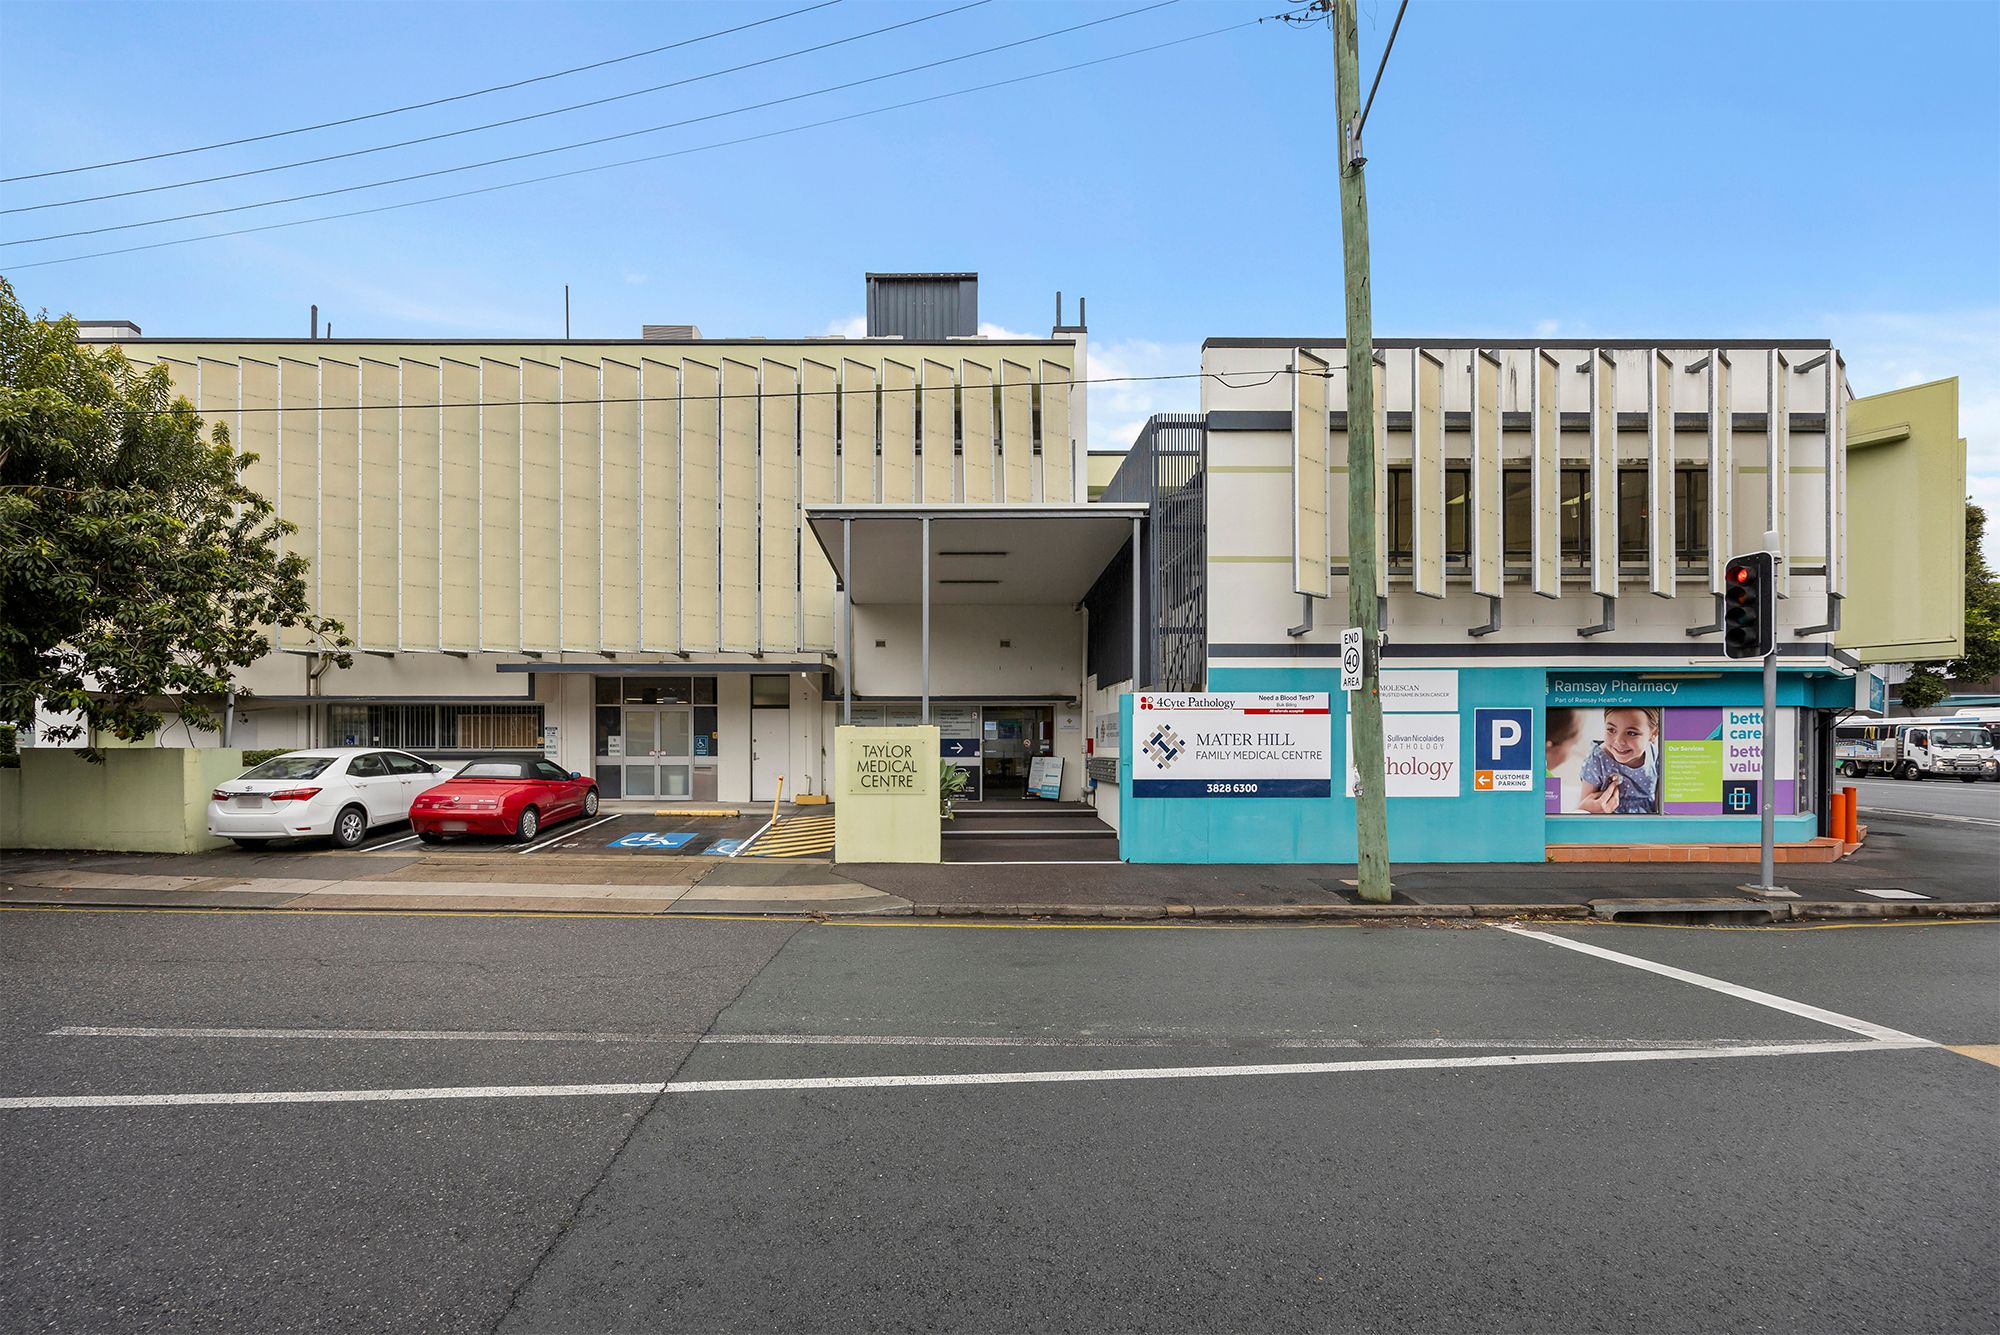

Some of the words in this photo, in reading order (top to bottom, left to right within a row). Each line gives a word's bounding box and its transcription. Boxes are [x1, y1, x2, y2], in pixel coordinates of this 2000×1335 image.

[1344, 632, 1359, 645] END
[1346, 654, 1358, 667] 40
[1343, 677, 1360, 687] AREA
[1554, 680, 1608, 695] Ramsay
[1611, 680, 1679, 695] Pharmacy
[1156, 697, 1186, 709] 4Cyte
[1188, 696, 1236, 710] Pathology
[1730, 712, 1764, 725] bett
[1196, 733, 1253, 746] MATER
[1257, 733, 1296, 746] HILL
[1387, 734, 1412, 742] Sullivan
[1412, 734, 1445, 742] Nicolaides
[1491, 719, 1522, 760] P
[862, 744, 912, 758] TAYLOR
[1195, 750, 1231, 760] FAMILY
[1233, 750, 1280, 760] MEDICAL
[1281, 750, 1323, 760] CENTRE
[1730, 745, 1764, 758] bett
[857, 760, 918, 773] MEDICAL
[1384, 756, 1454, 781] hology
[1729, 759, 1763, 773] valu
[861, 774, 913, 788] CENTRE
[1206, 783, 1232, 793] 3828
[1232, 783, 1258, 793] 6300
